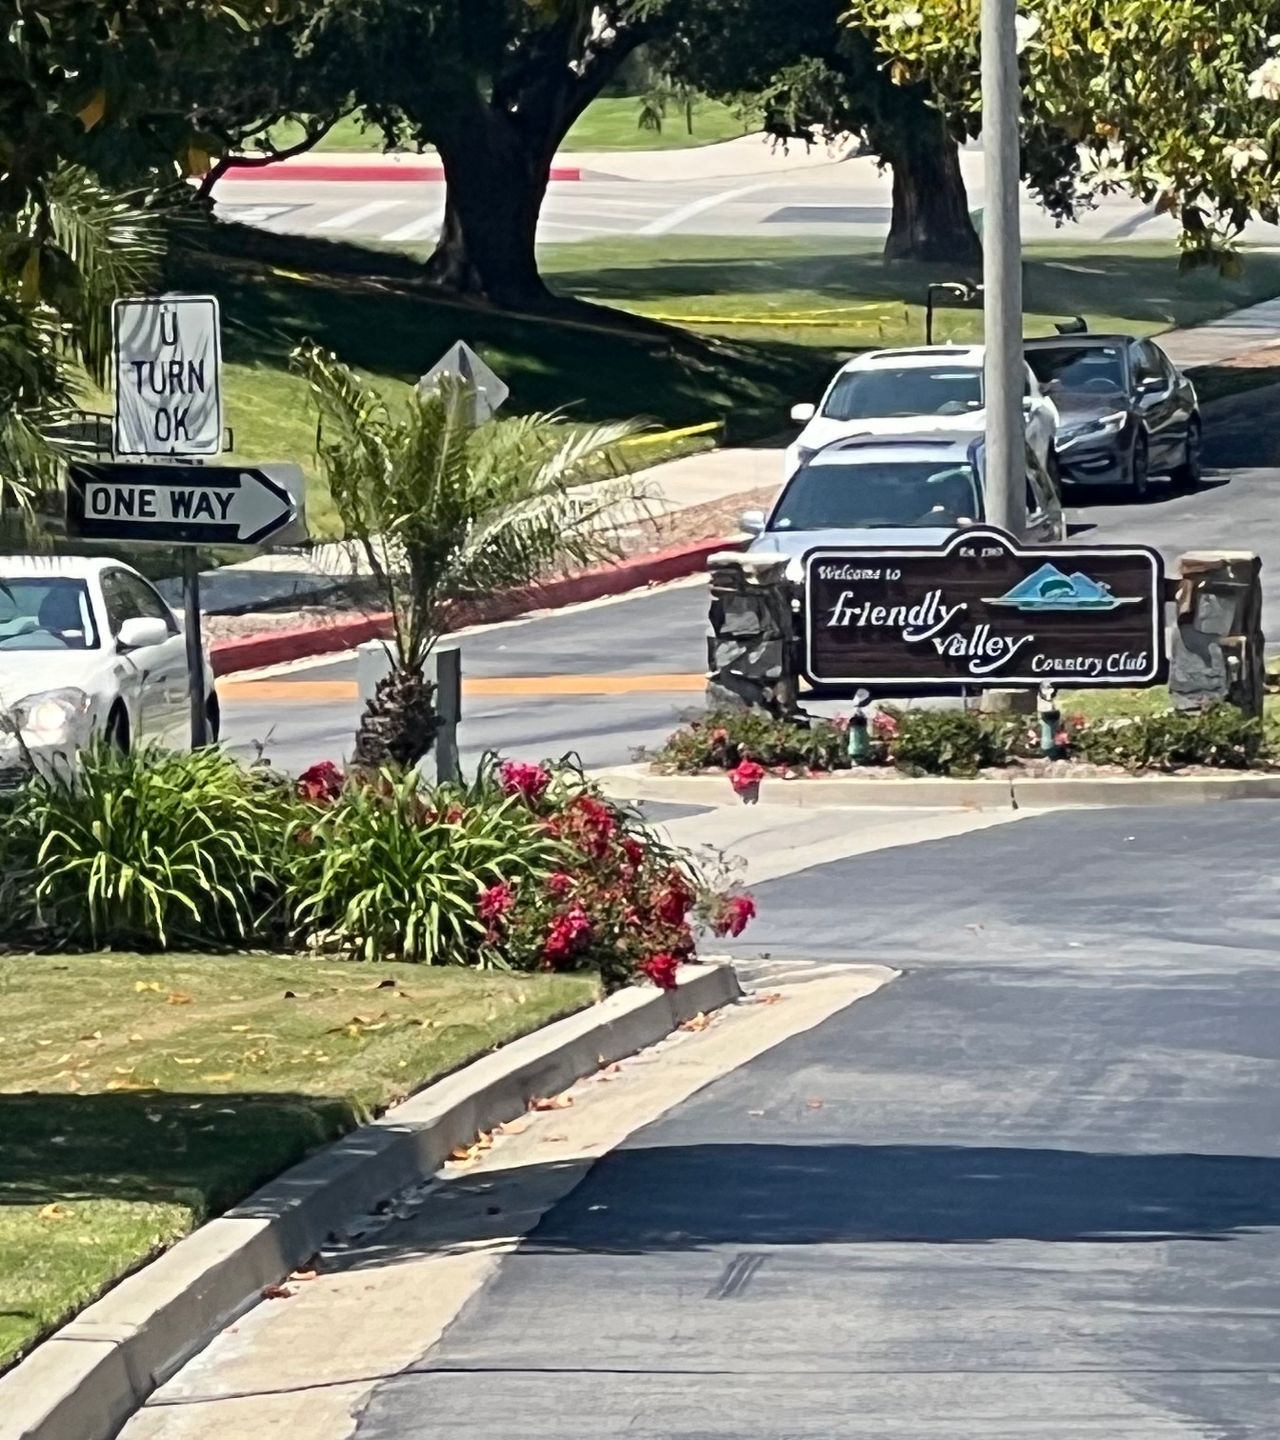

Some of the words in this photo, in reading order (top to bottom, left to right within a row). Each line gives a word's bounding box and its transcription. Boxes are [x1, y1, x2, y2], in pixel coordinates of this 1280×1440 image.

[161, 312, 177, 346] U
[131, 360, 205, 395] TURN
[155, 407, 191, 442] OK
[92, 487, 156, 517] ONE
[170, 490, 235, 520] WAY
[818, 565, 881, 580] Welcome
[885, 568, 901, 580] to
[827, 589, 968, 642] friendly
[932, 625, 1034, 674] valley
[1031, 654, 1102, 676] Country
[1107, 652, 1147, 671] Club
